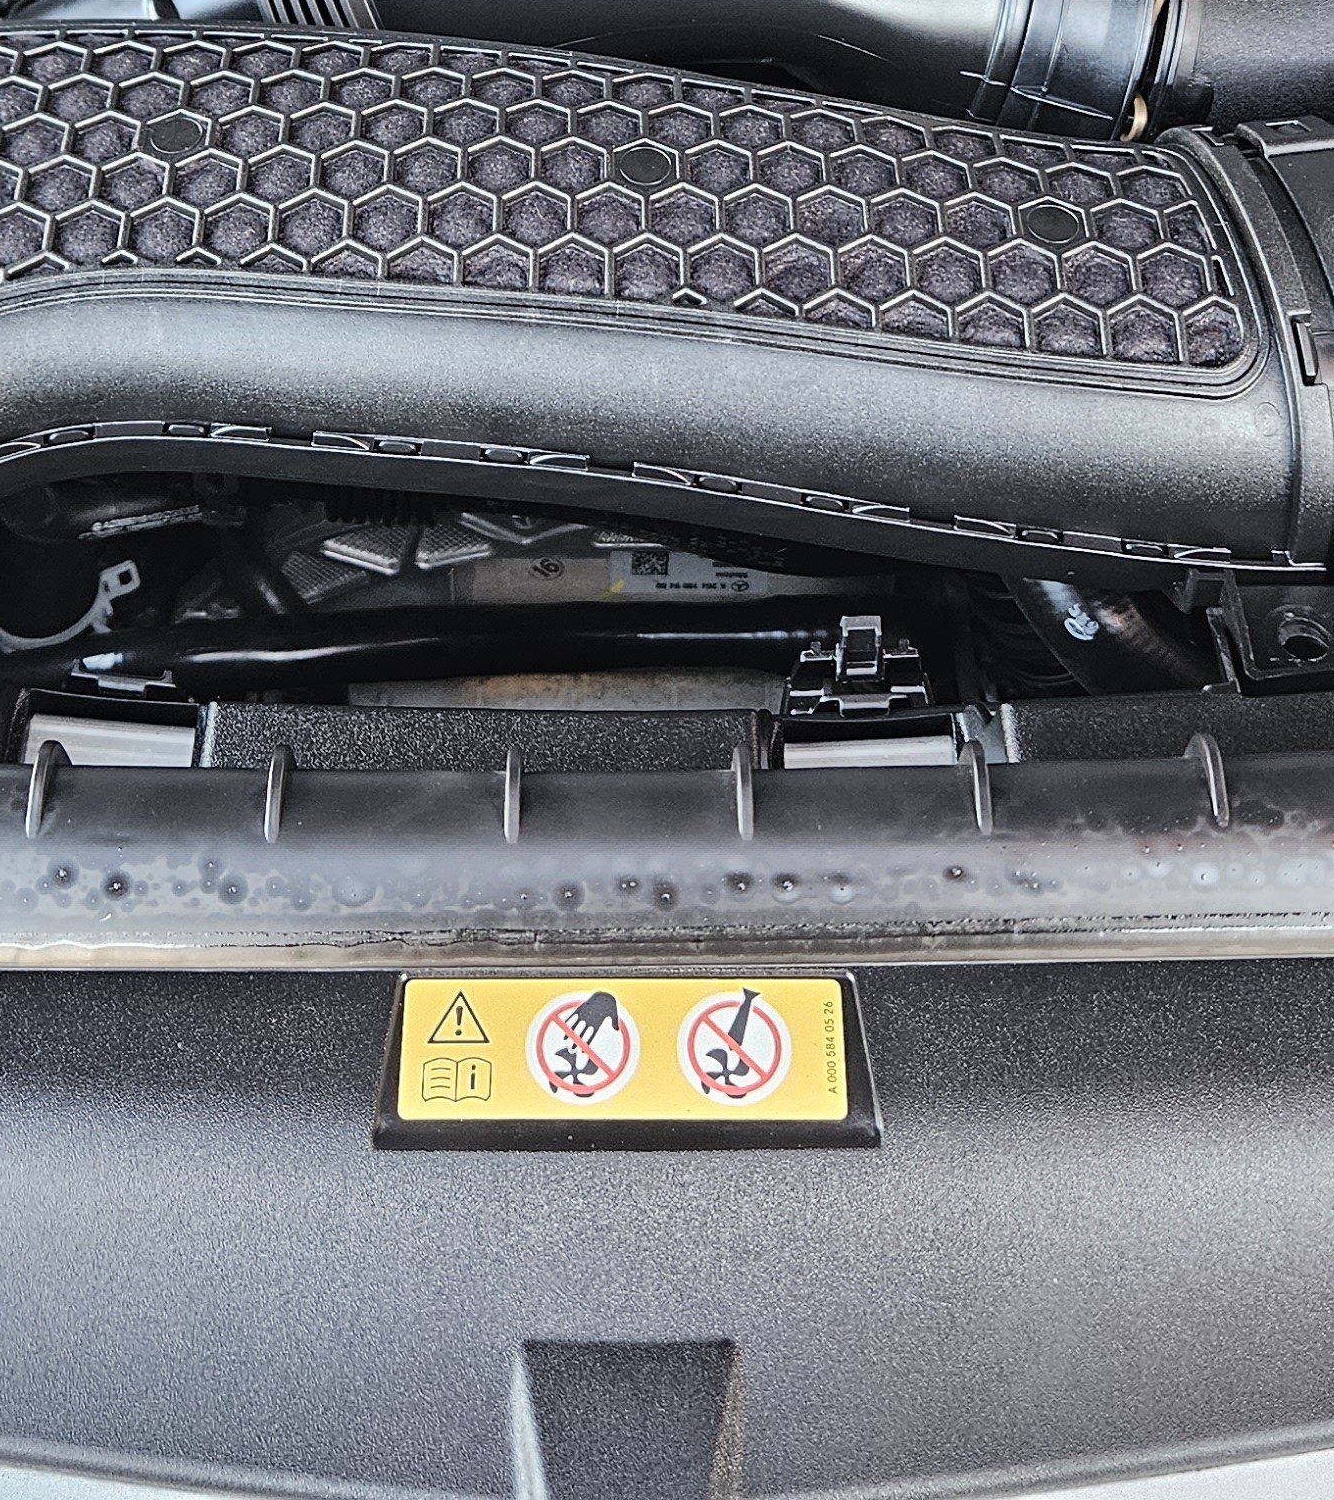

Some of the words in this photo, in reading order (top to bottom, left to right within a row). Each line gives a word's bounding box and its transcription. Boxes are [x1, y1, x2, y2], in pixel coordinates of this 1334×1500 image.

[823, 1001, 834, 1015] 26
[825, 1018, 835, 1033] 05
[826, 1037, 836, 1057] 584
[827, 1061, 838, 1083] 000
[828, 1086, 838, 1094] A
